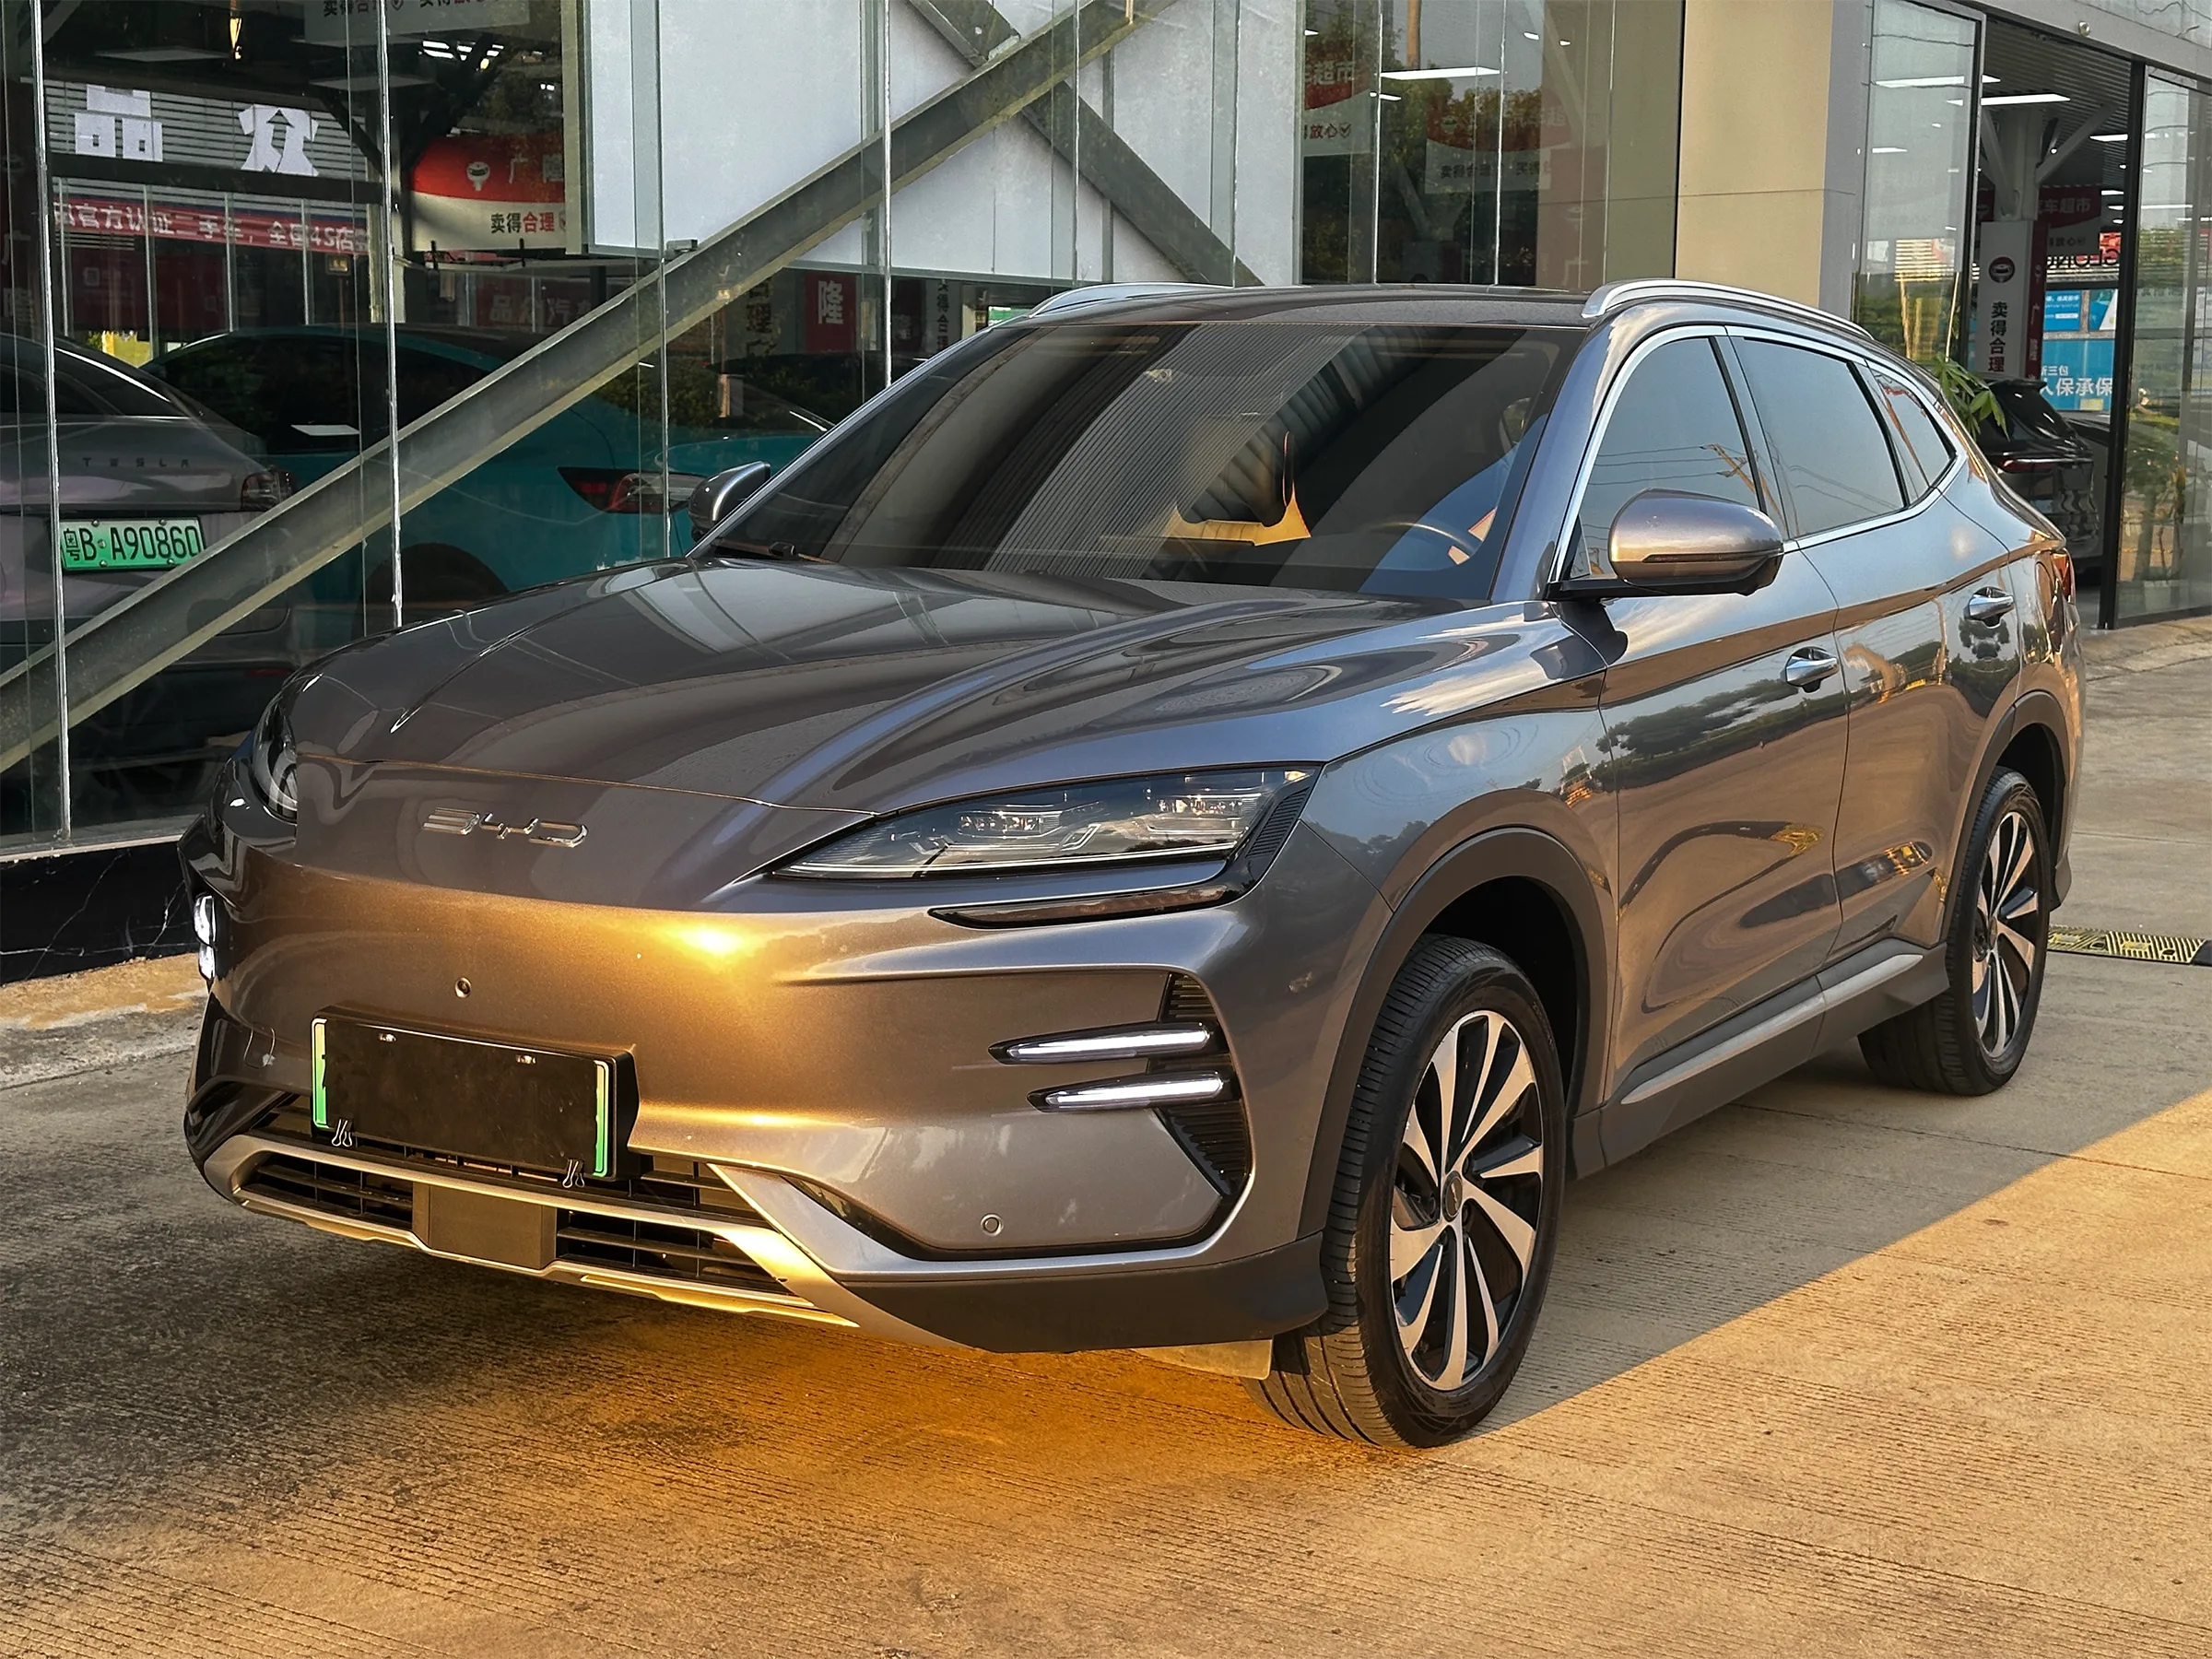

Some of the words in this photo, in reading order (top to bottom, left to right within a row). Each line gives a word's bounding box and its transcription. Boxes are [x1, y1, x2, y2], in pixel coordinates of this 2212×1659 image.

[1304, 123, 1338, 139] 放心
[490, 211, 555, 234] 卖得合理
[818, 279, 844, 324] 隆
[1988, 301, 2008, 372] 卖得合理
[83, 457, 190, 468] TESLA
[421, 806, 589, 849] BYD
